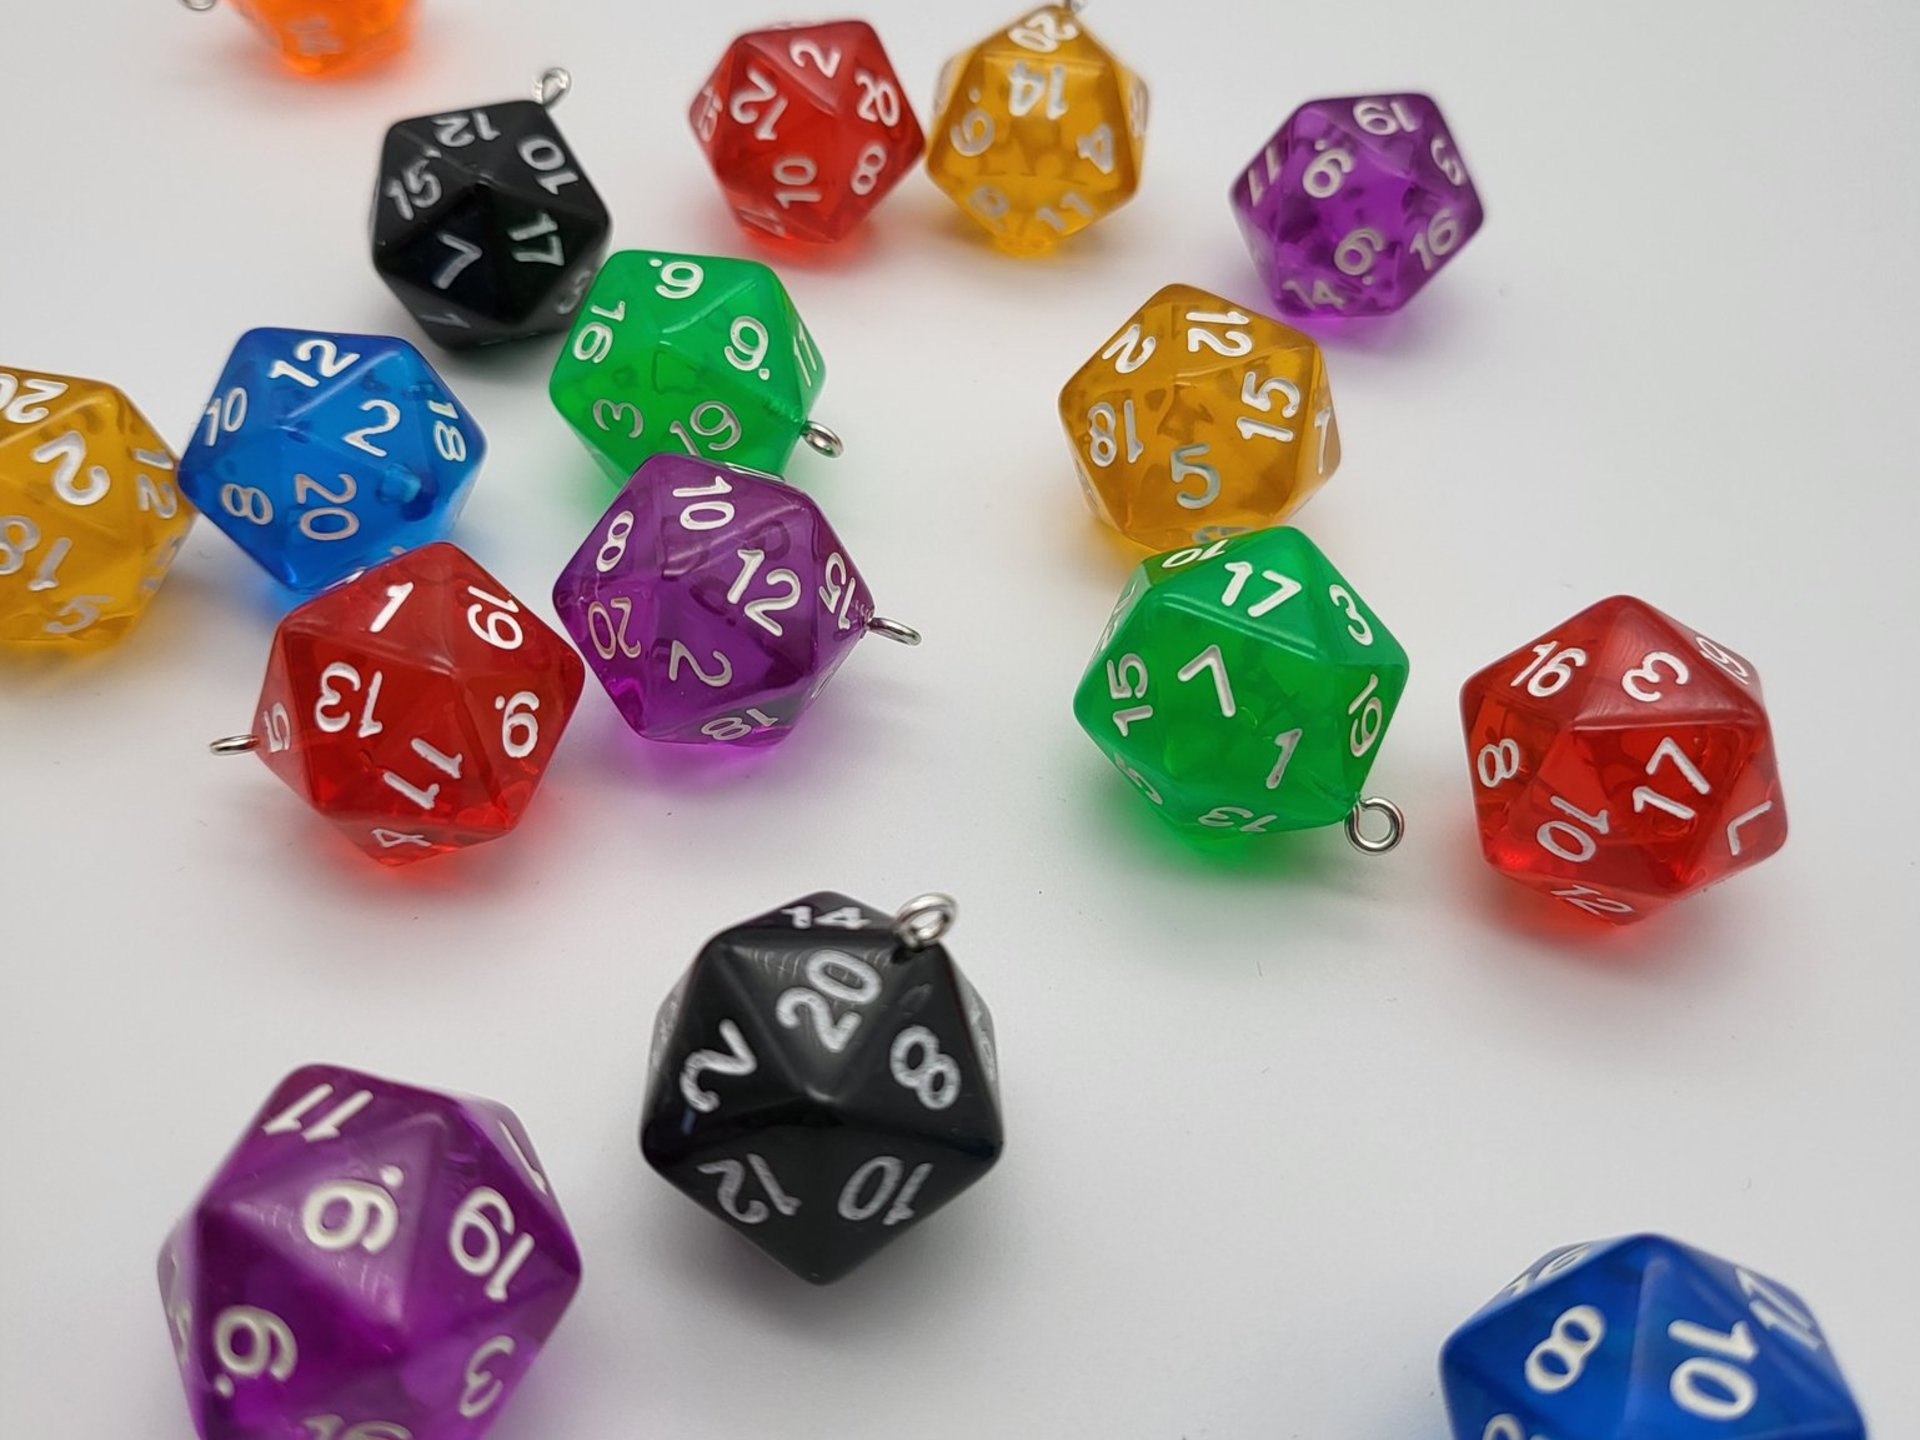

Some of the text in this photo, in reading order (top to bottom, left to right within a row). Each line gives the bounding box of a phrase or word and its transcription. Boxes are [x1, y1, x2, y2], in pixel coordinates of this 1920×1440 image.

[789, 38, 842, 79] 2
[1008, 11, 1080, 53] 20
[729, 69, 789, 141] 12
[854, 69, 900, 128] 20
[1007, 58, 1070, 120] 14
[1353, 100, 1418, 136] 19
[433, 109, 500, 148] 12
[1076, 122, 1113, 175] 4
[385, 147, 442, 221] 15
[517, 138, 580, 196] 10
[772, 154, 822, 209] 10
[850, 142, 888, 196] 8
[1247, 145, 1281, 207] 11
[431, 231, 483, 291] 7
[506, 212, 565, 267] 17
[1409, 208, 1458, 271] 16
[1281, 279, 1347, 311] 14
[269, 339, 360, 388] 12
[572, 300, 626, 365] 16
[792, 321, 818, 387] 11
[1101, 323, 1157, 374] 2
[1185, 310, 1253, 358] 12
[203, 386, 249, 448] 10
[341, 398, 402, 458] 2
[426, 399, 467, 464] 18
[592, 398, 644, 439] 3
[668, 399, 743, 457] 19
[1087, 398, 1144, 468] 18
[1236, 370, 1301, 443] 15
[31, 430, 111, 506] 2
[133, 448, 178, 519] 12
[1170, 442, 1222, 510] 5
[220, 482, 274, 526] 8
[293, 472, 361, 542] 20
[672, 476, 736, 531] 10
[0, 515, 73, 591] 18
[596, 510, 635, 573] 8
[45, 594, 116, 635] 5
[369, 581, 414, 633] 1
[466, 584, 524, 651] 19
[727, 549, 801, 637] 12
[818, 552, 857, 630] 15
[1220, 561, 1302, 618] 17
[1329, 584, 1374, 646] 3
[587, 597, 642, 661] 20
[668, 640, 733, 687] 2
[1177, 644, 1236, 718] 7
[1510, 640, 1587, 698] 16
[1622, 651, 1690, 702] 3
[314, 662, 383, 738] 13
[700, 708, 779, 741] 18
[1107, 653, 1153, 737] 15
[1348, 674, 1383, 758] 19
[382, 737, 463, 810] 11
[1265, 728, 1302, 790] 1
[1477, 738, 1520, 788] 8
[1632, 737, 1712, 821] 17
[371, 827, 432, 848] 4
[1198, 806, 1277, 833] 13
[1536, 795, 1610, 863] 10
[1726, 800, 1773, 857] 7
[782, 906, 872, 930] 14
[775, 949, 882, 1053] 20
[679, 1019, 757, 1113] 2
[890, 1025, 961, 1110] 8
[260, 1083, 374, 1143] 11
[697, 1152, 801, 1225] 12
[836, 1155, 934, 1226] 10
[449, 1185, 536, 1303] 19
[458, 1335, 516, 1420] 3
[1524, 1304, 1605, 1393] 8
[1667, 1319, 1759, 1421] 10
